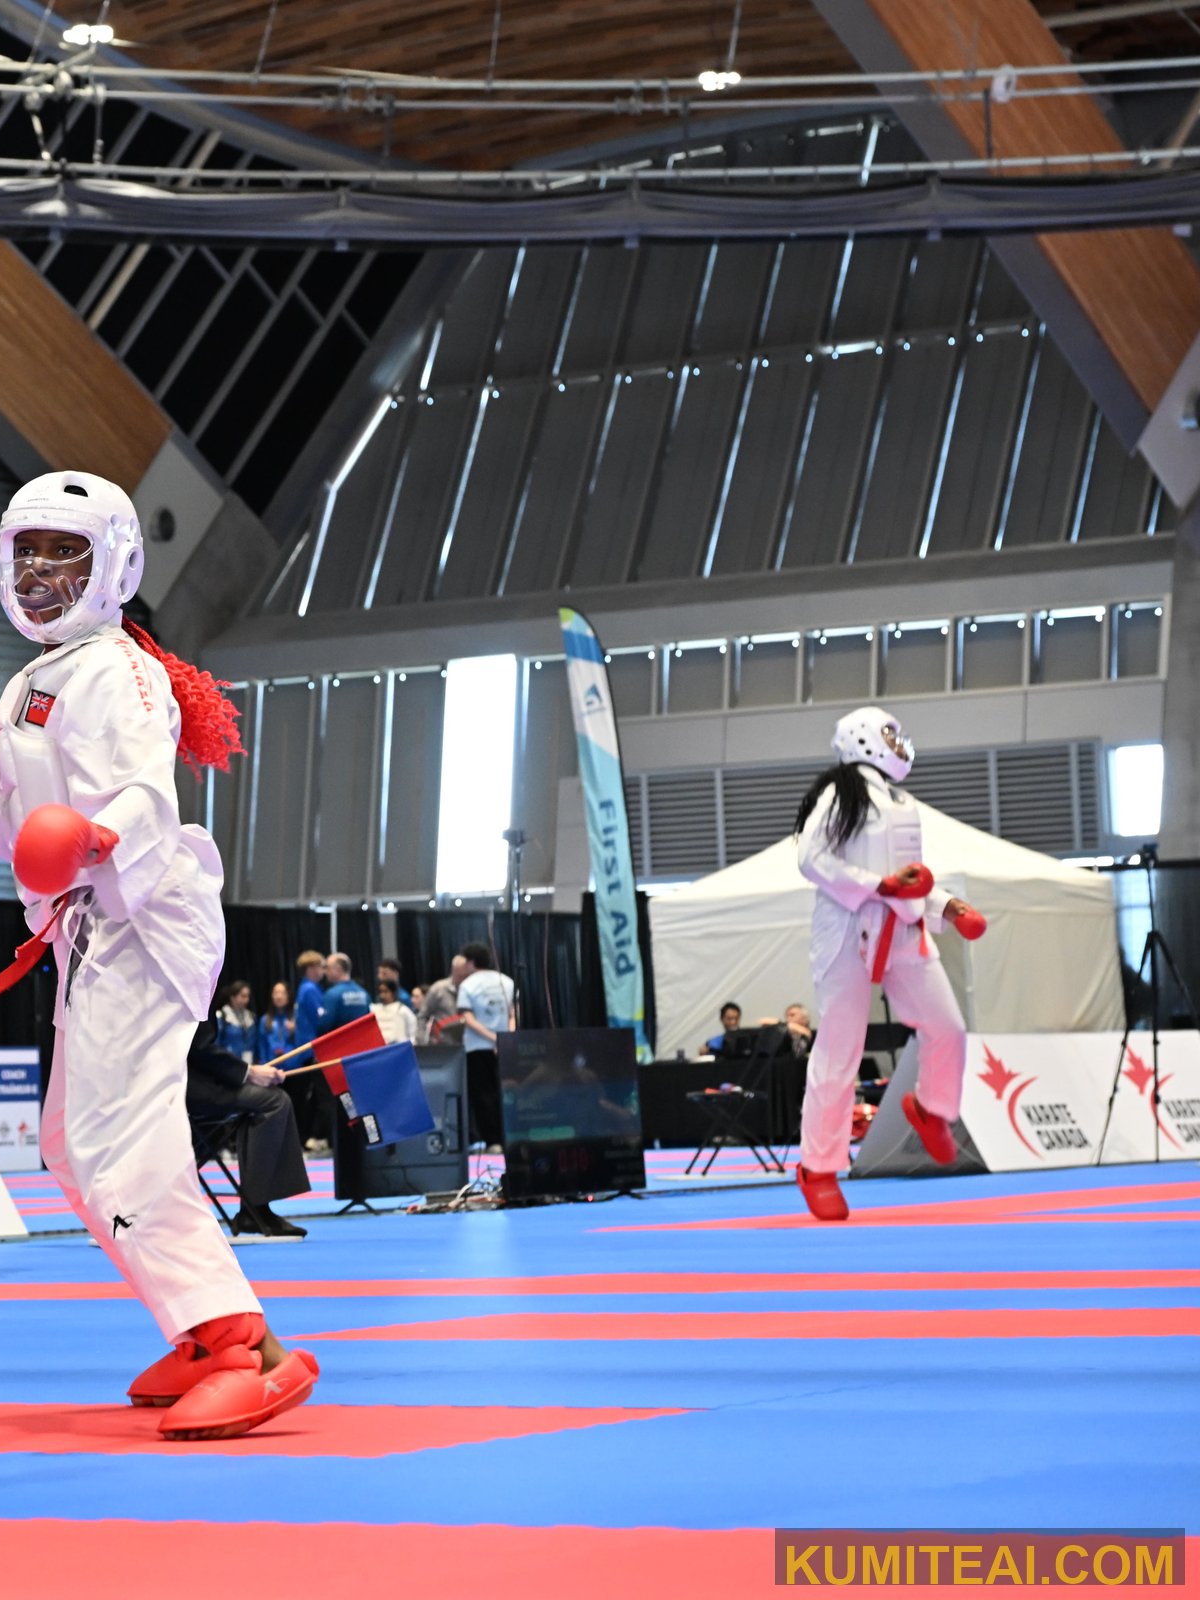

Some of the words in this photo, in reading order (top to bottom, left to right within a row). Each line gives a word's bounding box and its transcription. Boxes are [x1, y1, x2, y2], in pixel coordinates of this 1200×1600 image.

[599, 799, 622, 895] First
[611, 911, 636, 977] Aid
[1021, 1103, 1077, 1125] KARATE
[1163, 1098, 1200, 1119] KARAT
[1036, 1128, 1092, 1151] CANADA
